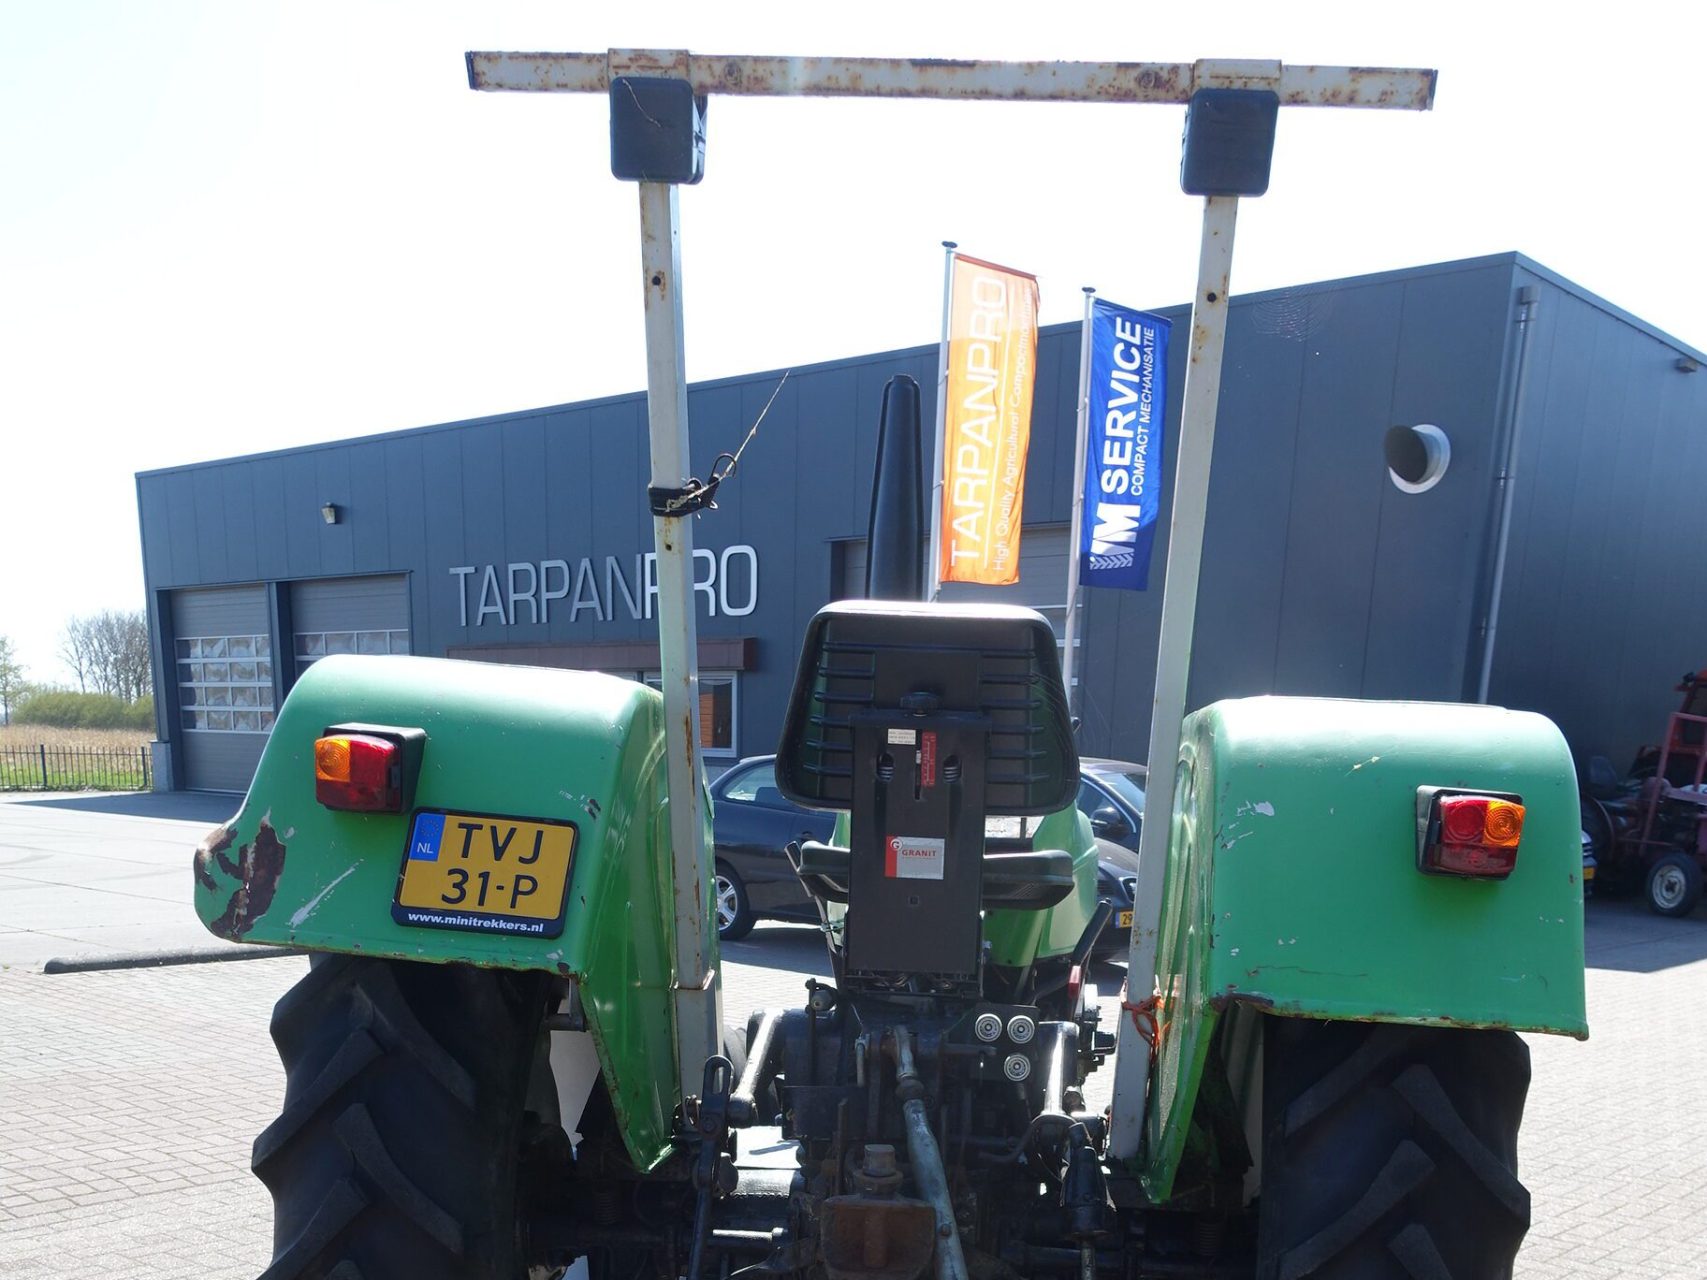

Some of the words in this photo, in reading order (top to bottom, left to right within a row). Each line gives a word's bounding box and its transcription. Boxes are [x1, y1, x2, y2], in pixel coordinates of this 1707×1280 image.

[1139, 327, 1155, 424] MECHANISATIE
[950, 274, 1007, 567] TARPANPRO
[1100, 316, 1142, 495] SERVICE
[1002, 413, 1021, 486] Agricultural
[1130, 425, 1149, 496] COMPACT
[994, 490, 1015, 537] Quality
[993, 540, 1011, 571] High
[417, 842, 434, 854] NL
[458, 822, 544, 865] TVJ
[901, 849, 937, 858] GRANIT
[441, 868, 538, 909] 31-P
[408, 911, 544, 933] www.minitrekkers.nl
